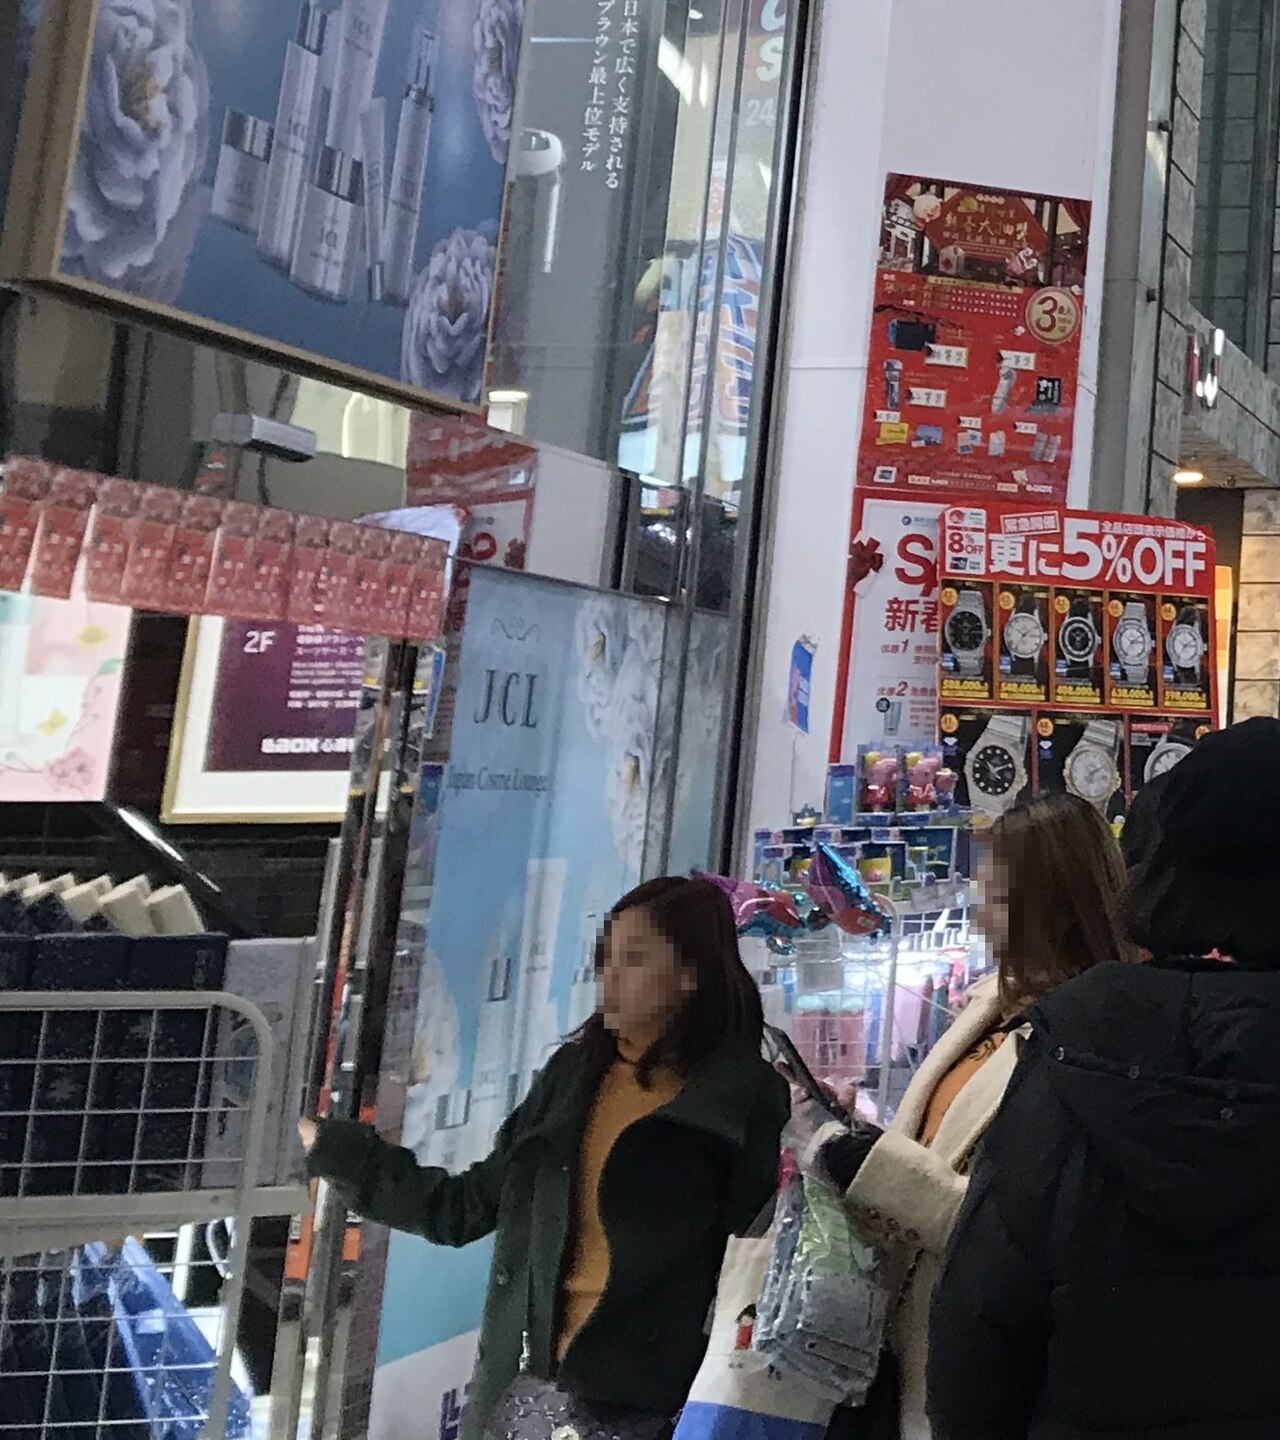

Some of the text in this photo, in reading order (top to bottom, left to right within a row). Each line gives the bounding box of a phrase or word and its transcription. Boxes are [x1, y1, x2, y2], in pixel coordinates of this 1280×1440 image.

[605, 0, 639, 189] 日本で広く支持される
[988, 533, 1060, 577] 更に
[244, 630, 277, 654] 2F
[473, 668, 538, 729] JCL
